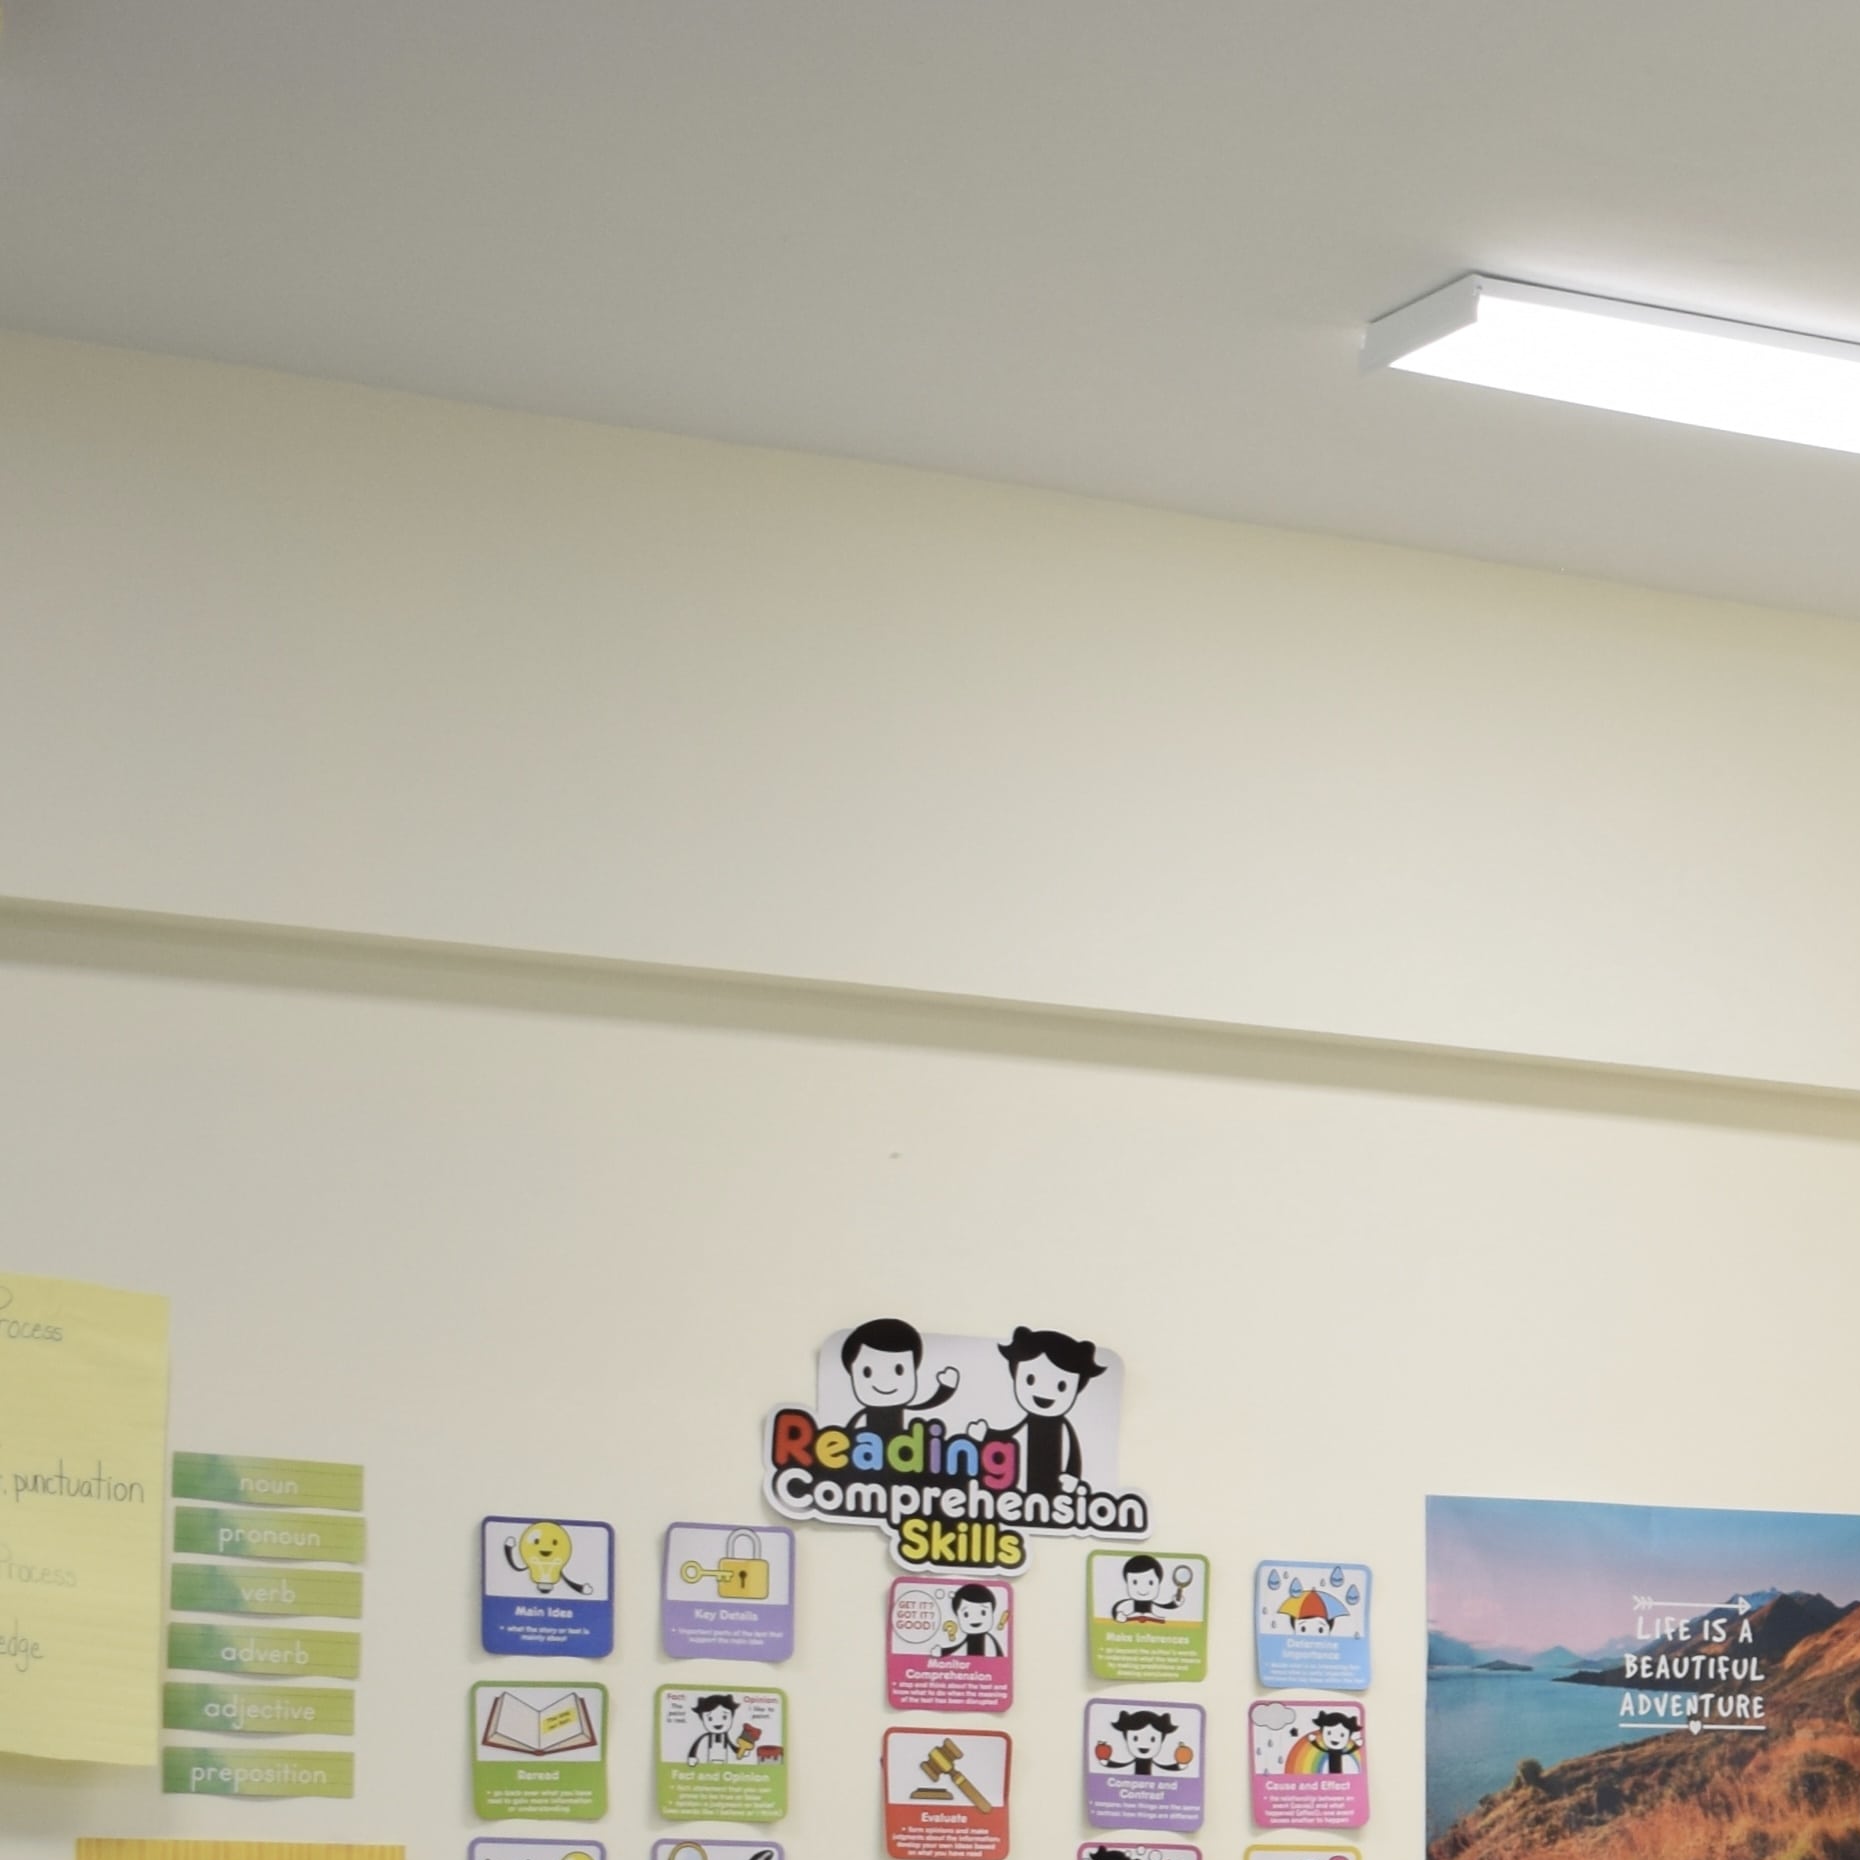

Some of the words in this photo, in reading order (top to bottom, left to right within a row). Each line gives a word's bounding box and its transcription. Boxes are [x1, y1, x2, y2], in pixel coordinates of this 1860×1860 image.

[0, 1318, 63, 1341] rocess
[773, 1413, 1017, 1490] Reading
[14, 1458, 144, 1503] punctuation
[239, 1476, 298, 1495] noun
[775, 1468, 1144, 1529] Comprehension
[219, 1526, 321, 1552] pronoun
[900, 1519, 1023, 1565] Skills
[240, 1579, 296, 1604] verb
[514, 1606, 545, 1617] Main
[547, 1607, 573, 1619] Idea
[694, 1609, 716, 1622] Key
[719, 1610, 759, 1621] Details
[1636, 1616, 1690, 1642] LIFE
[1703, 1617, 1728, 1643] IS
[1739, 1619, 1753, 1644] A
[221, 1640, 309, 1665] adverb
[928, 1659, 970, 1669] Monitor
[905, 1669, 992, 1681] Comprehension
[1624, 1654, 1765, 1682] BEAUTIFUL
[204, 1699, 316, 1730] adjective
[1620, 1692, 1765, 1720] ADVENTURE
[190, 1764, 328, 1792] preposition
[517, 1769, 560, 1781] Reread
[697, 1771, 720, 1782] and
[722, 1771, 770, 1784] Opinion
[1107, 1778, 1156, 1791] Compare
[1157, 1780, 1178, 1791] and
[1265, 1780, 1297, 1791] Cause
[1298, 1782, 1318, 1791] and
[1320, 1780, 1351, 1791] Effect
[1119, 1789, 1164, 1800] Contrast
[921, 1812, 968, 1823] Evaluate
